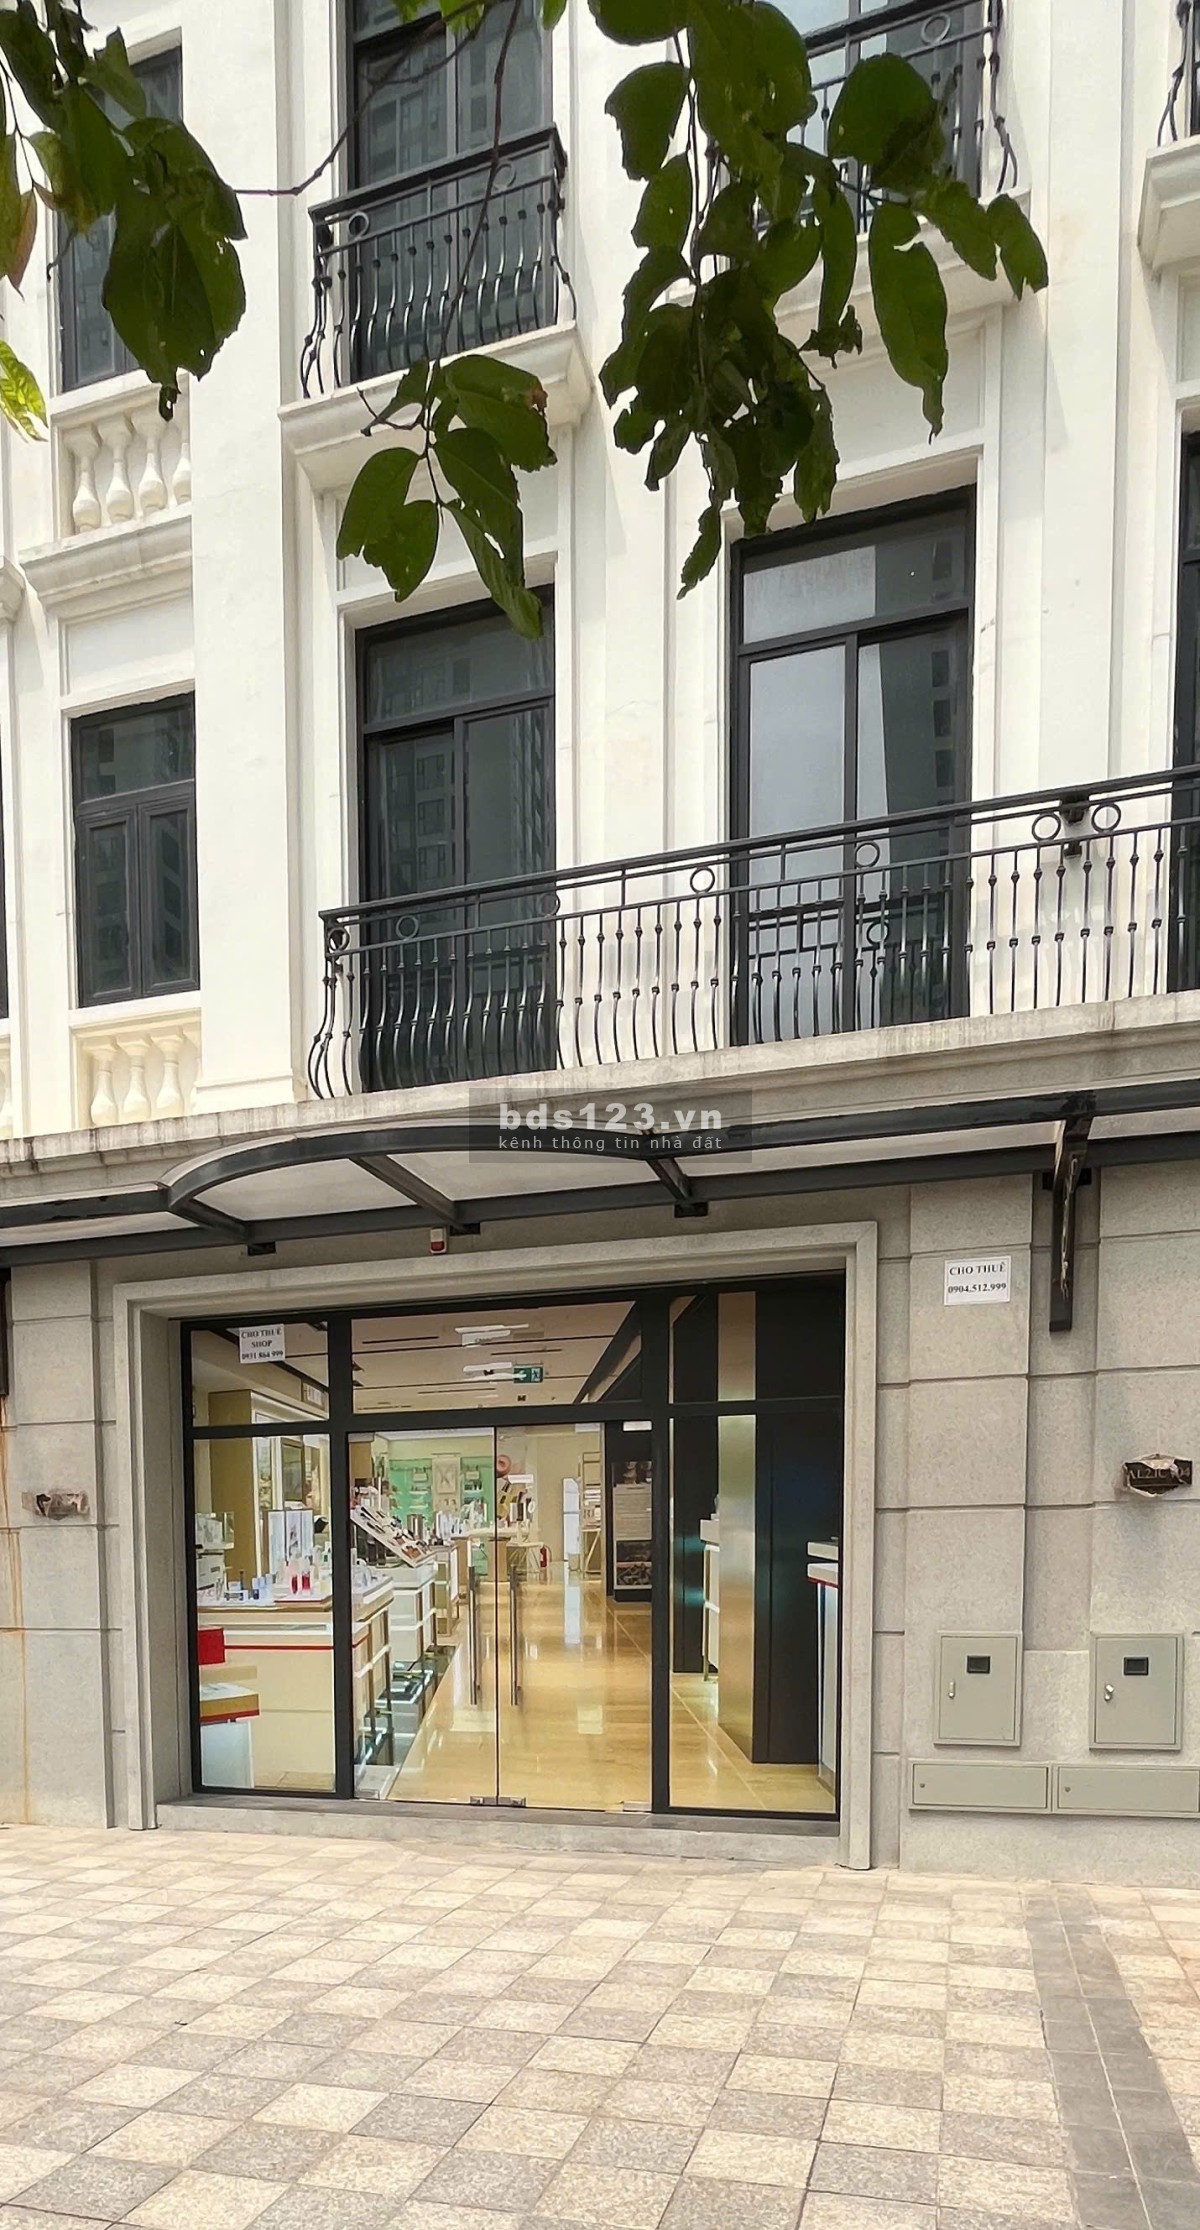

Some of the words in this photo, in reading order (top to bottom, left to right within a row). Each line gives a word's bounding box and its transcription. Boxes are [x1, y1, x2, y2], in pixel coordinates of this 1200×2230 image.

[949, 1266, 974, 1275] CHO
[975, 1261, 1006, 1274] THUÊ
[948, 1282, 1007, 1293] 0904.512.999
[251, 1340, 272, 1348] SHOP
